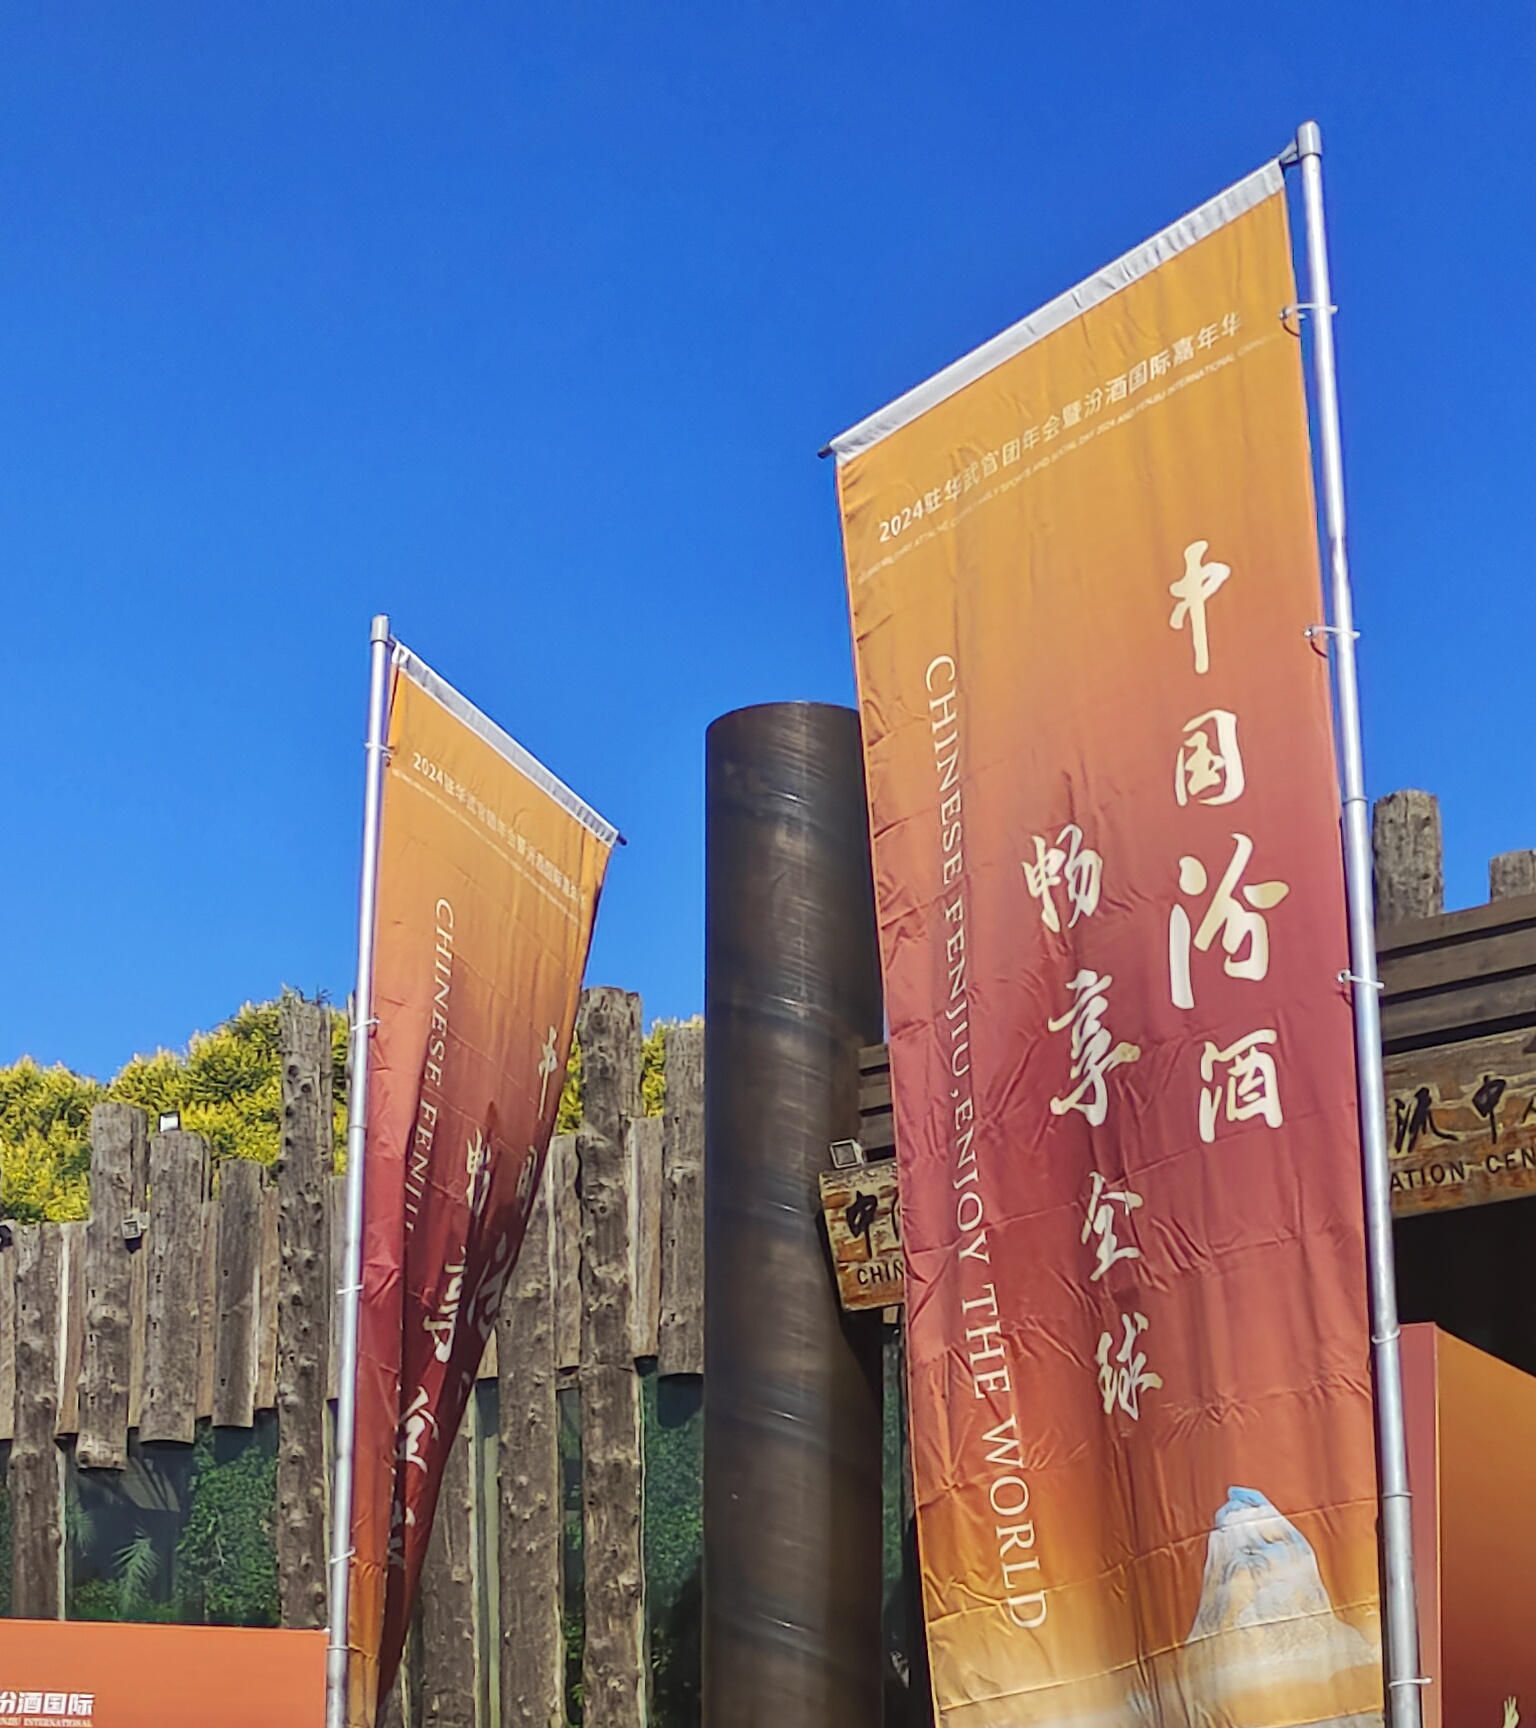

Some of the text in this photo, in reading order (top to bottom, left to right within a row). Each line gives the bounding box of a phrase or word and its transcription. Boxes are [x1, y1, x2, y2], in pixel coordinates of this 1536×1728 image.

[925, 655, 963, 885] CHINESE
[1168, 540, 1289, 1143] 中国汾酒
[424, 899, 455, 1087] CHINESE
[1022, 824, 1163, 1420] 畅享全球
[1390, 1160, 1465, 1192] ATION
[857, 1259, 904, 1285] CHIN
[960, 1283, 1013, 1400] THE
[980, 1416, 1047, 1630] WORLD
